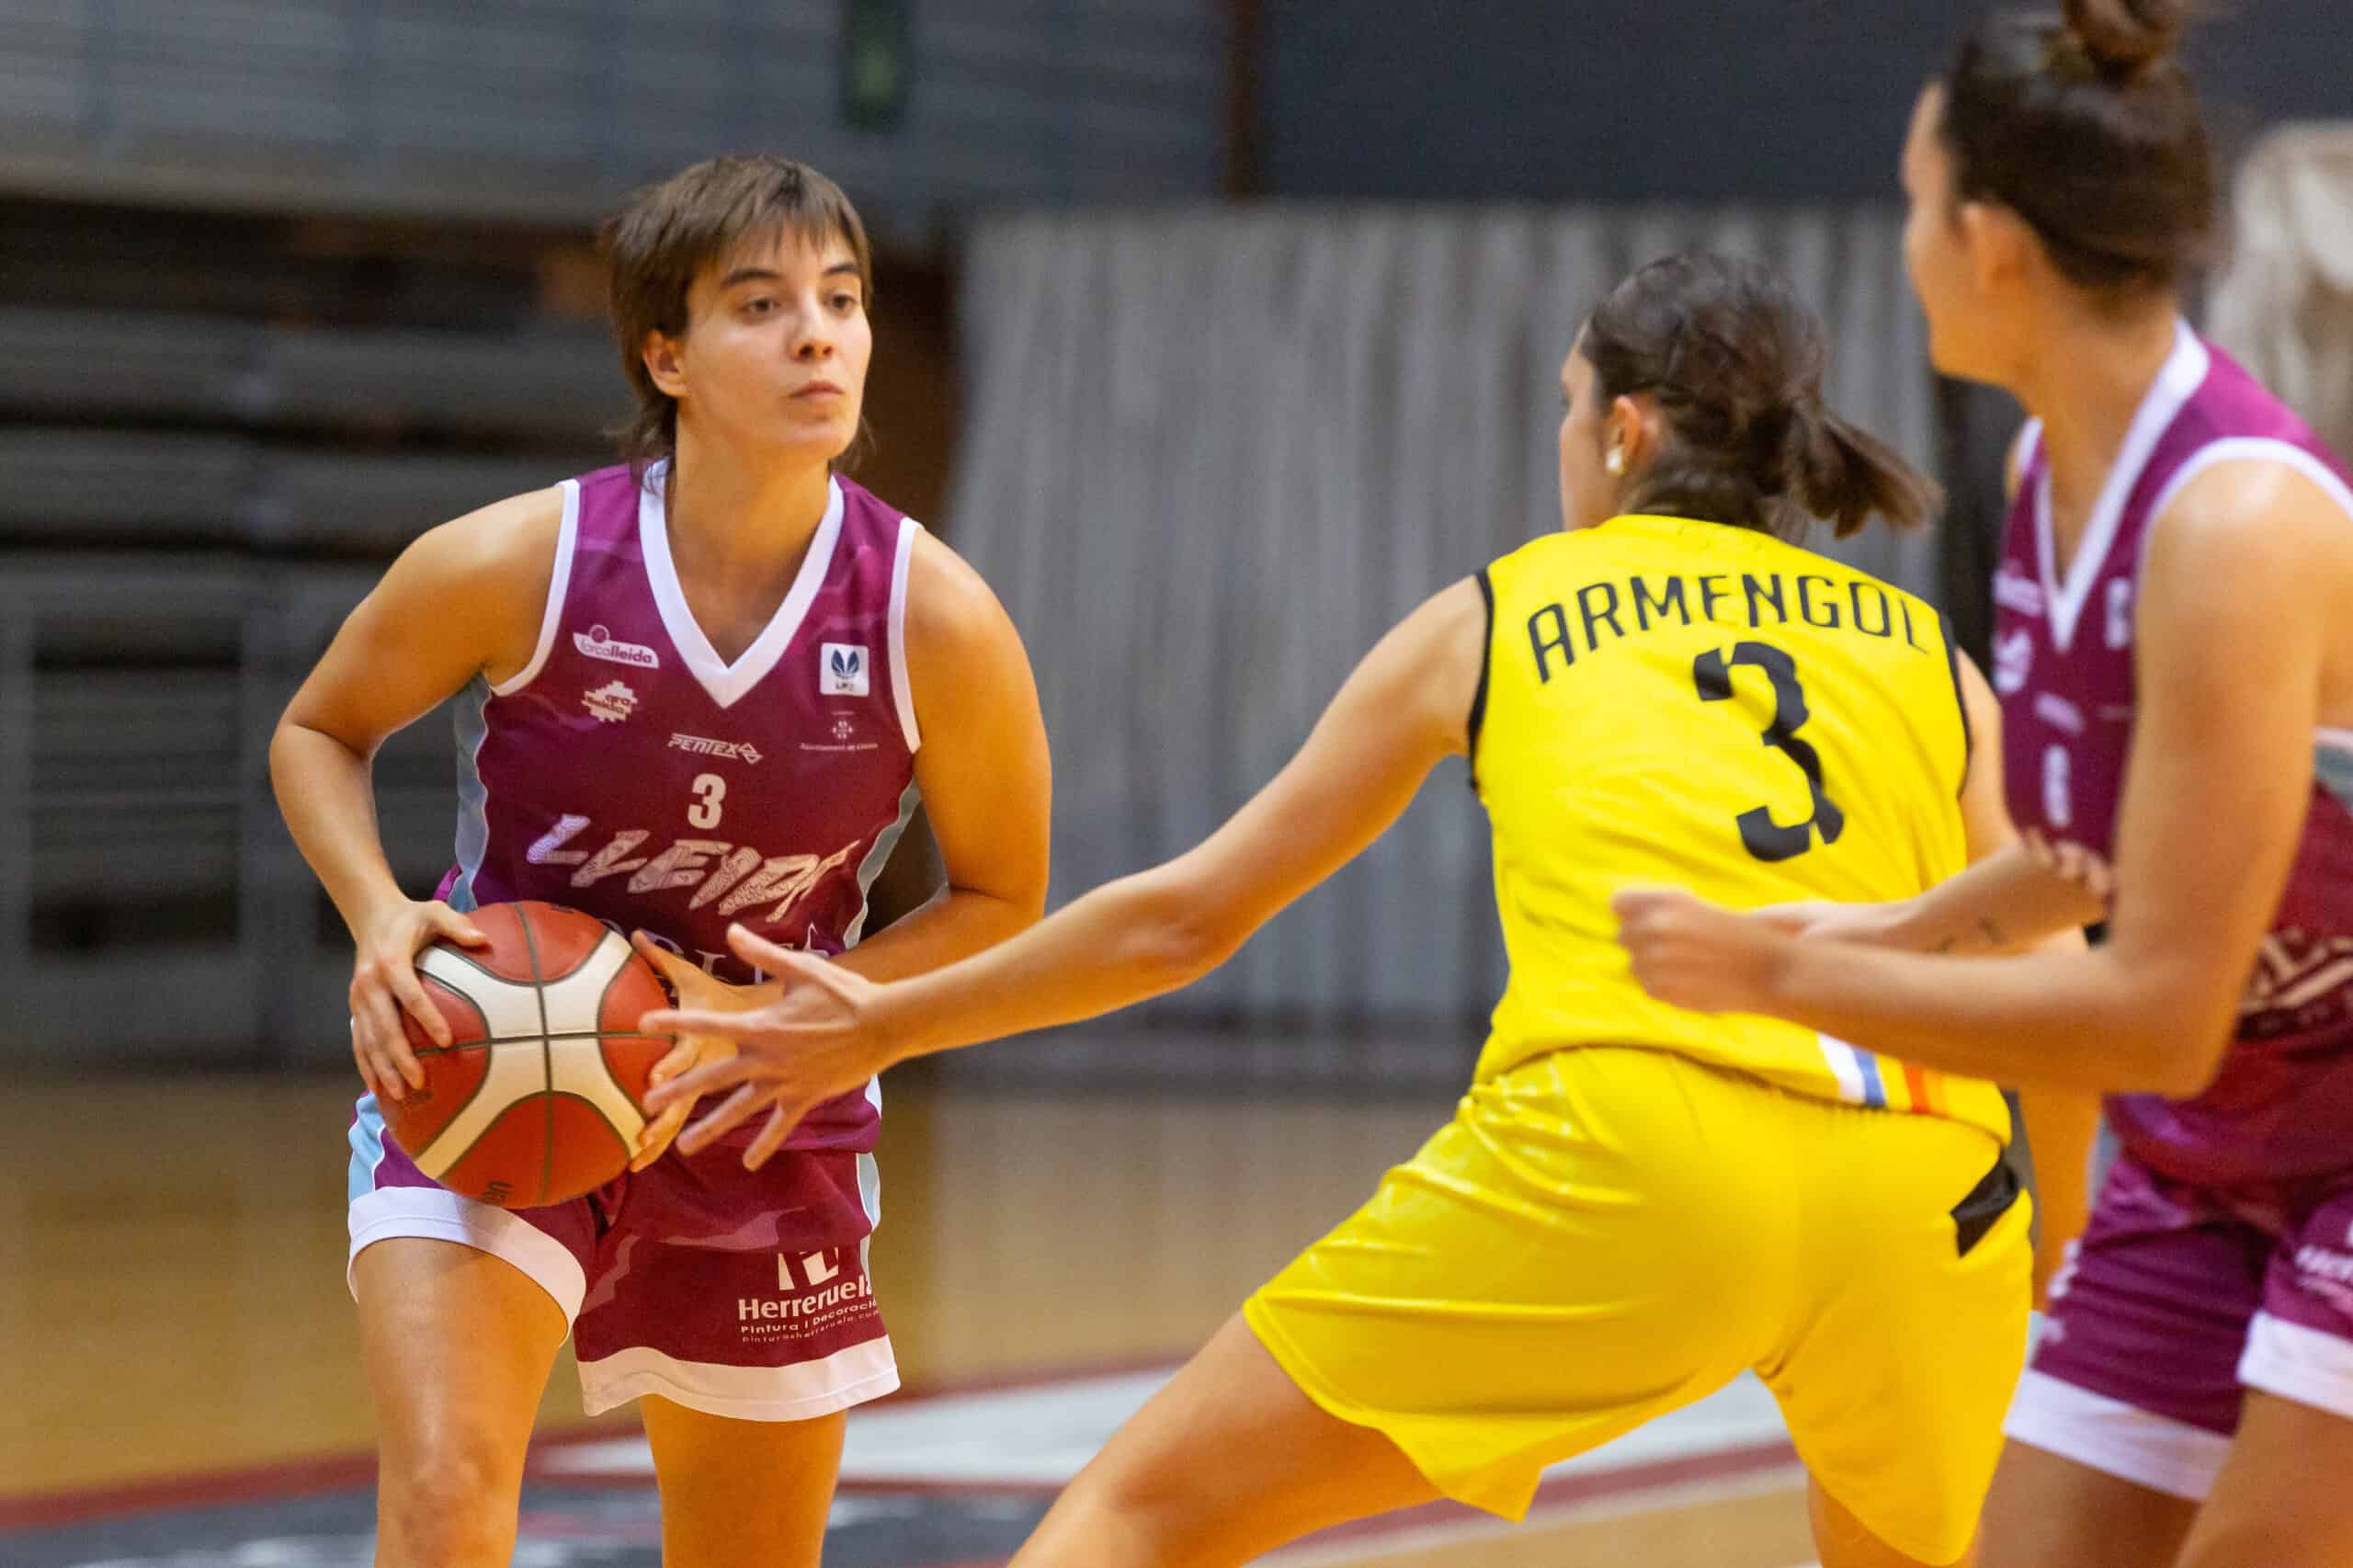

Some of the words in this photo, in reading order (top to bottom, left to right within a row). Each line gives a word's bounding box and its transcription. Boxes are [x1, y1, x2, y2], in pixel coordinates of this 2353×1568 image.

[1527, 572, 1929, 685] ARMENGOL
[688, 773, 726, 830] 3
[1693, 641, 1845, 862] 3
